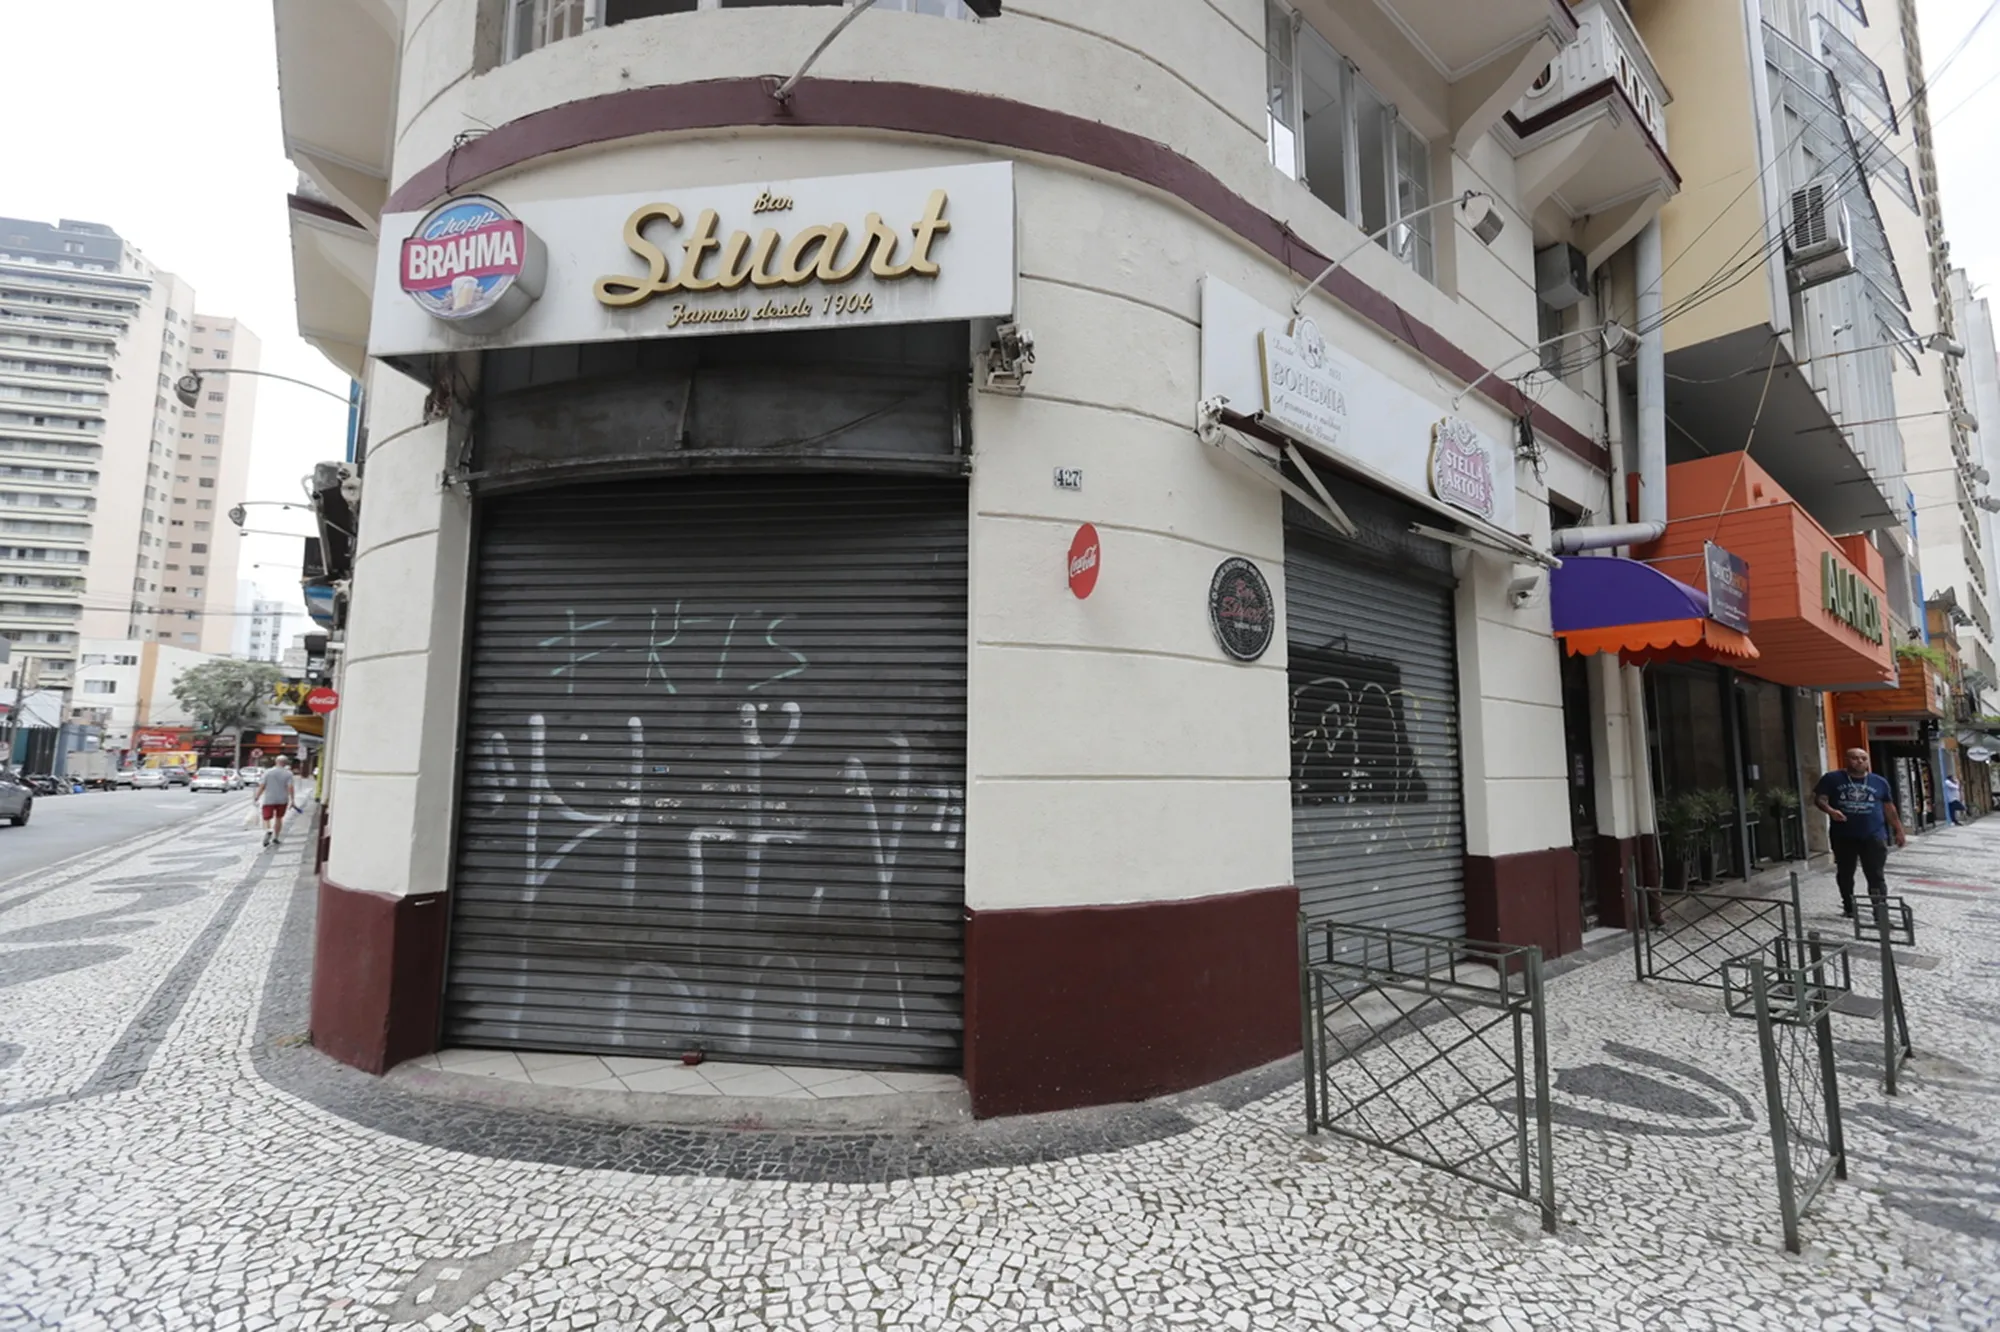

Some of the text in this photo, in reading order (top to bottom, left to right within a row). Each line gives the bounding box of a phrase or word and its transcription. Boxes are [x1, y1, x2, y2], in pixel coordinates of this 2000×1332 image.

[752, 191, 793, 214] Bar
[424, 211, 500, 241] Chopp
[409, 231, 518, 280] BRAHMA
[593, 188, 952, 307] Stuart
[666, 292, 873, 328] Famoso desde 1904
[1057, 469, 1079, 487] 427
[1446, 449, 1485, 482] STELLA
[1447, 470, 1486, 502] ARTOIS
